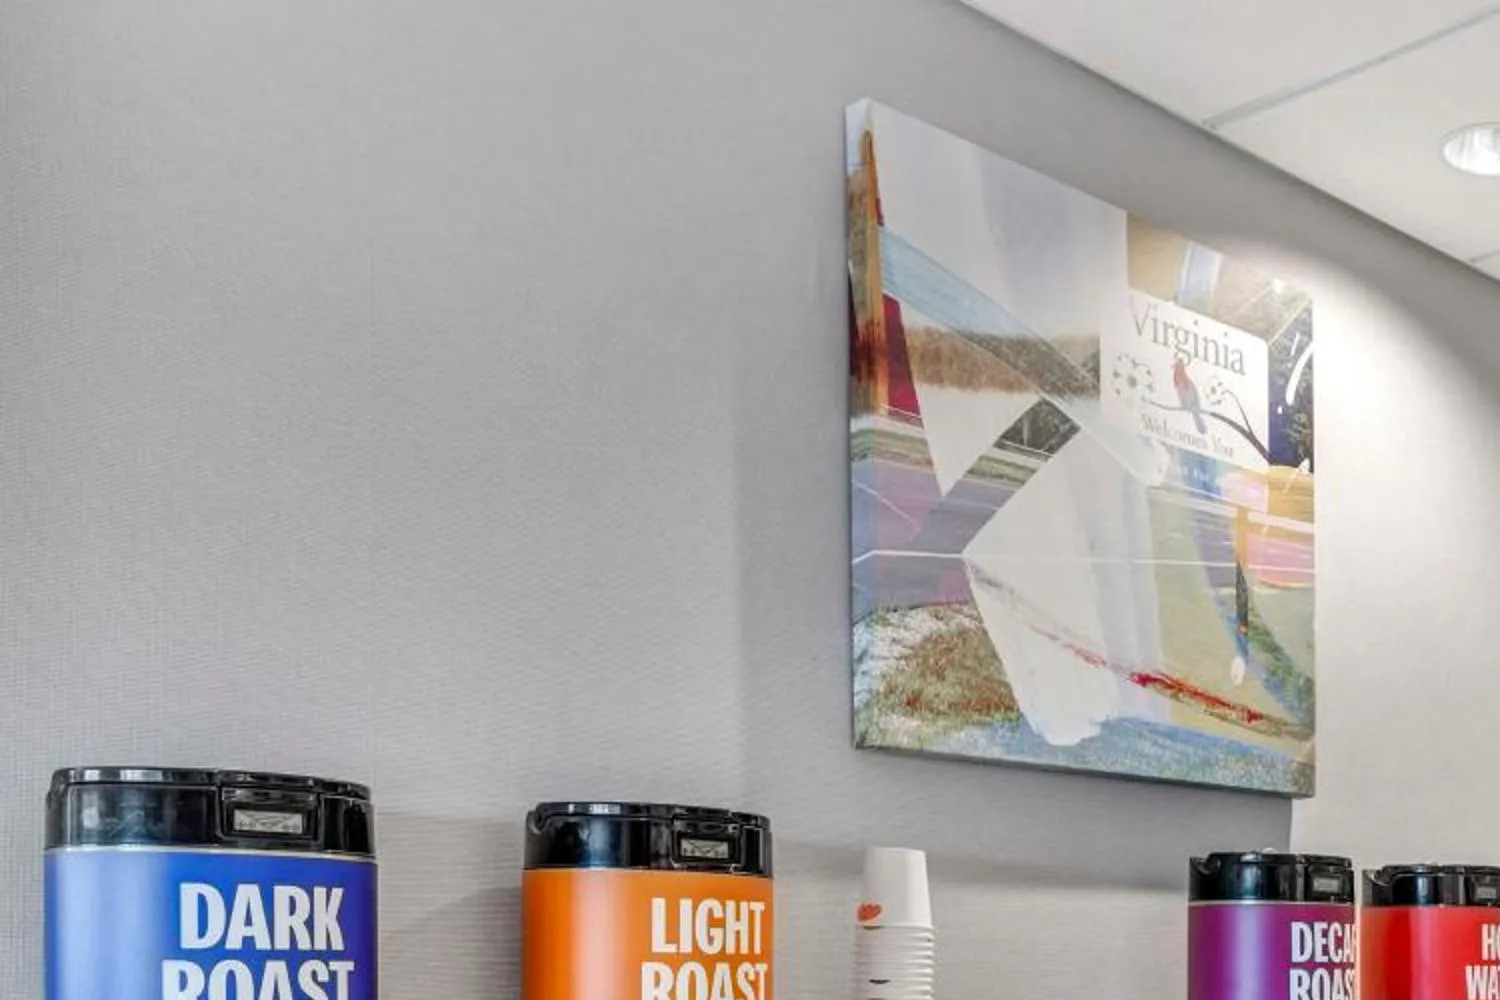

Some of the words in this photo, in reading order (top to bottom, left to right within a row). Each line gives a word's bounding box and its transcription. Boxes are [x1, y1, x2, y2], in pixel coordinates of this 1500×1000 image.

[1129, 295, 1247, 377] Virginia
[179, 881, 345, 952] DARK
[650, 896, 766, 956] LIGHT
